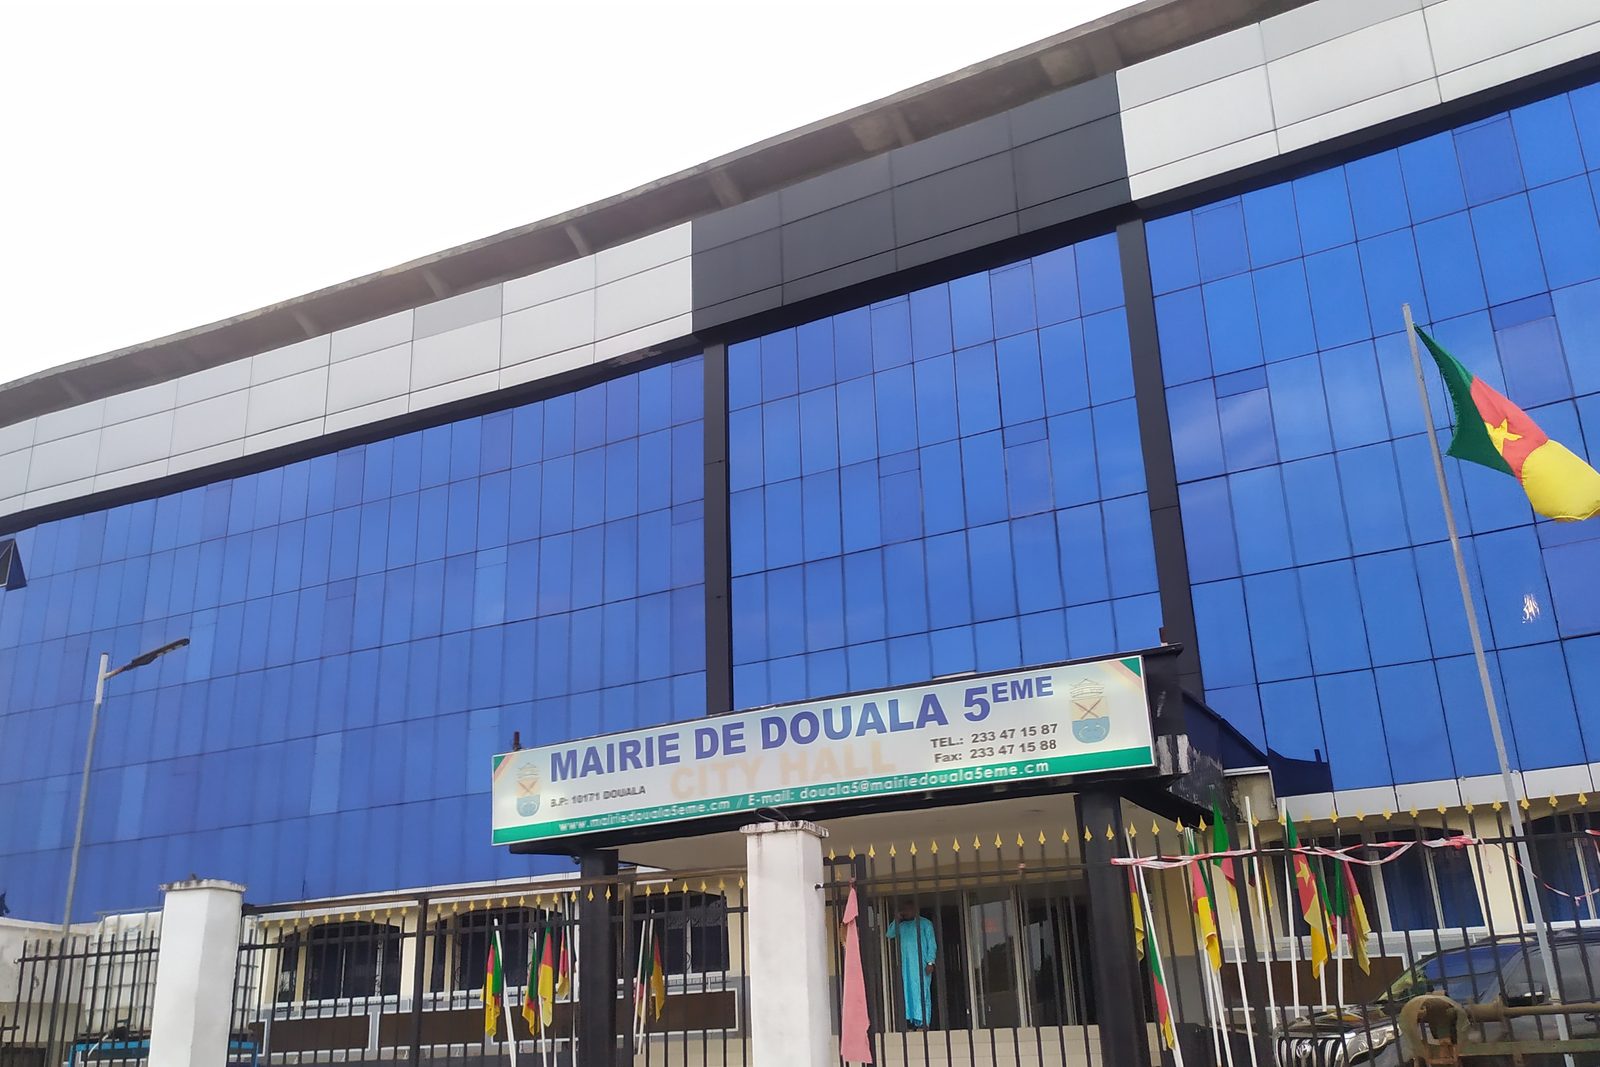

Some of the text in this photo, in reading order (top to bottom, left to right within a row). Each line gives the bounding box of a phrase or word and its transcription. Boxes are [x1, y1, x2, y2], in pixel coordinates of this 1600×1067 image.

[551, 731, 681, 782] MAIRIE
[694, 721, 746, 760] DE
[761, 693, 949, 750] DOUALA
[930, 723, 1058, 748] TEL.: 233 47 15 87
[934, 739, 1057, 763] Fax: 233 47 15 88
[670, 740, 897, 799] CITY HALL
[558, 800, 731, 832] www.mairiedouala5eme.cm
[747, 789, 795, 806] E-mail:
[800, 762, 1049, 800] douala5@mairiedouala5eme.cm
[572, 792, 600, 804] 10171
[603, 785, 646, 800] DOUALA
